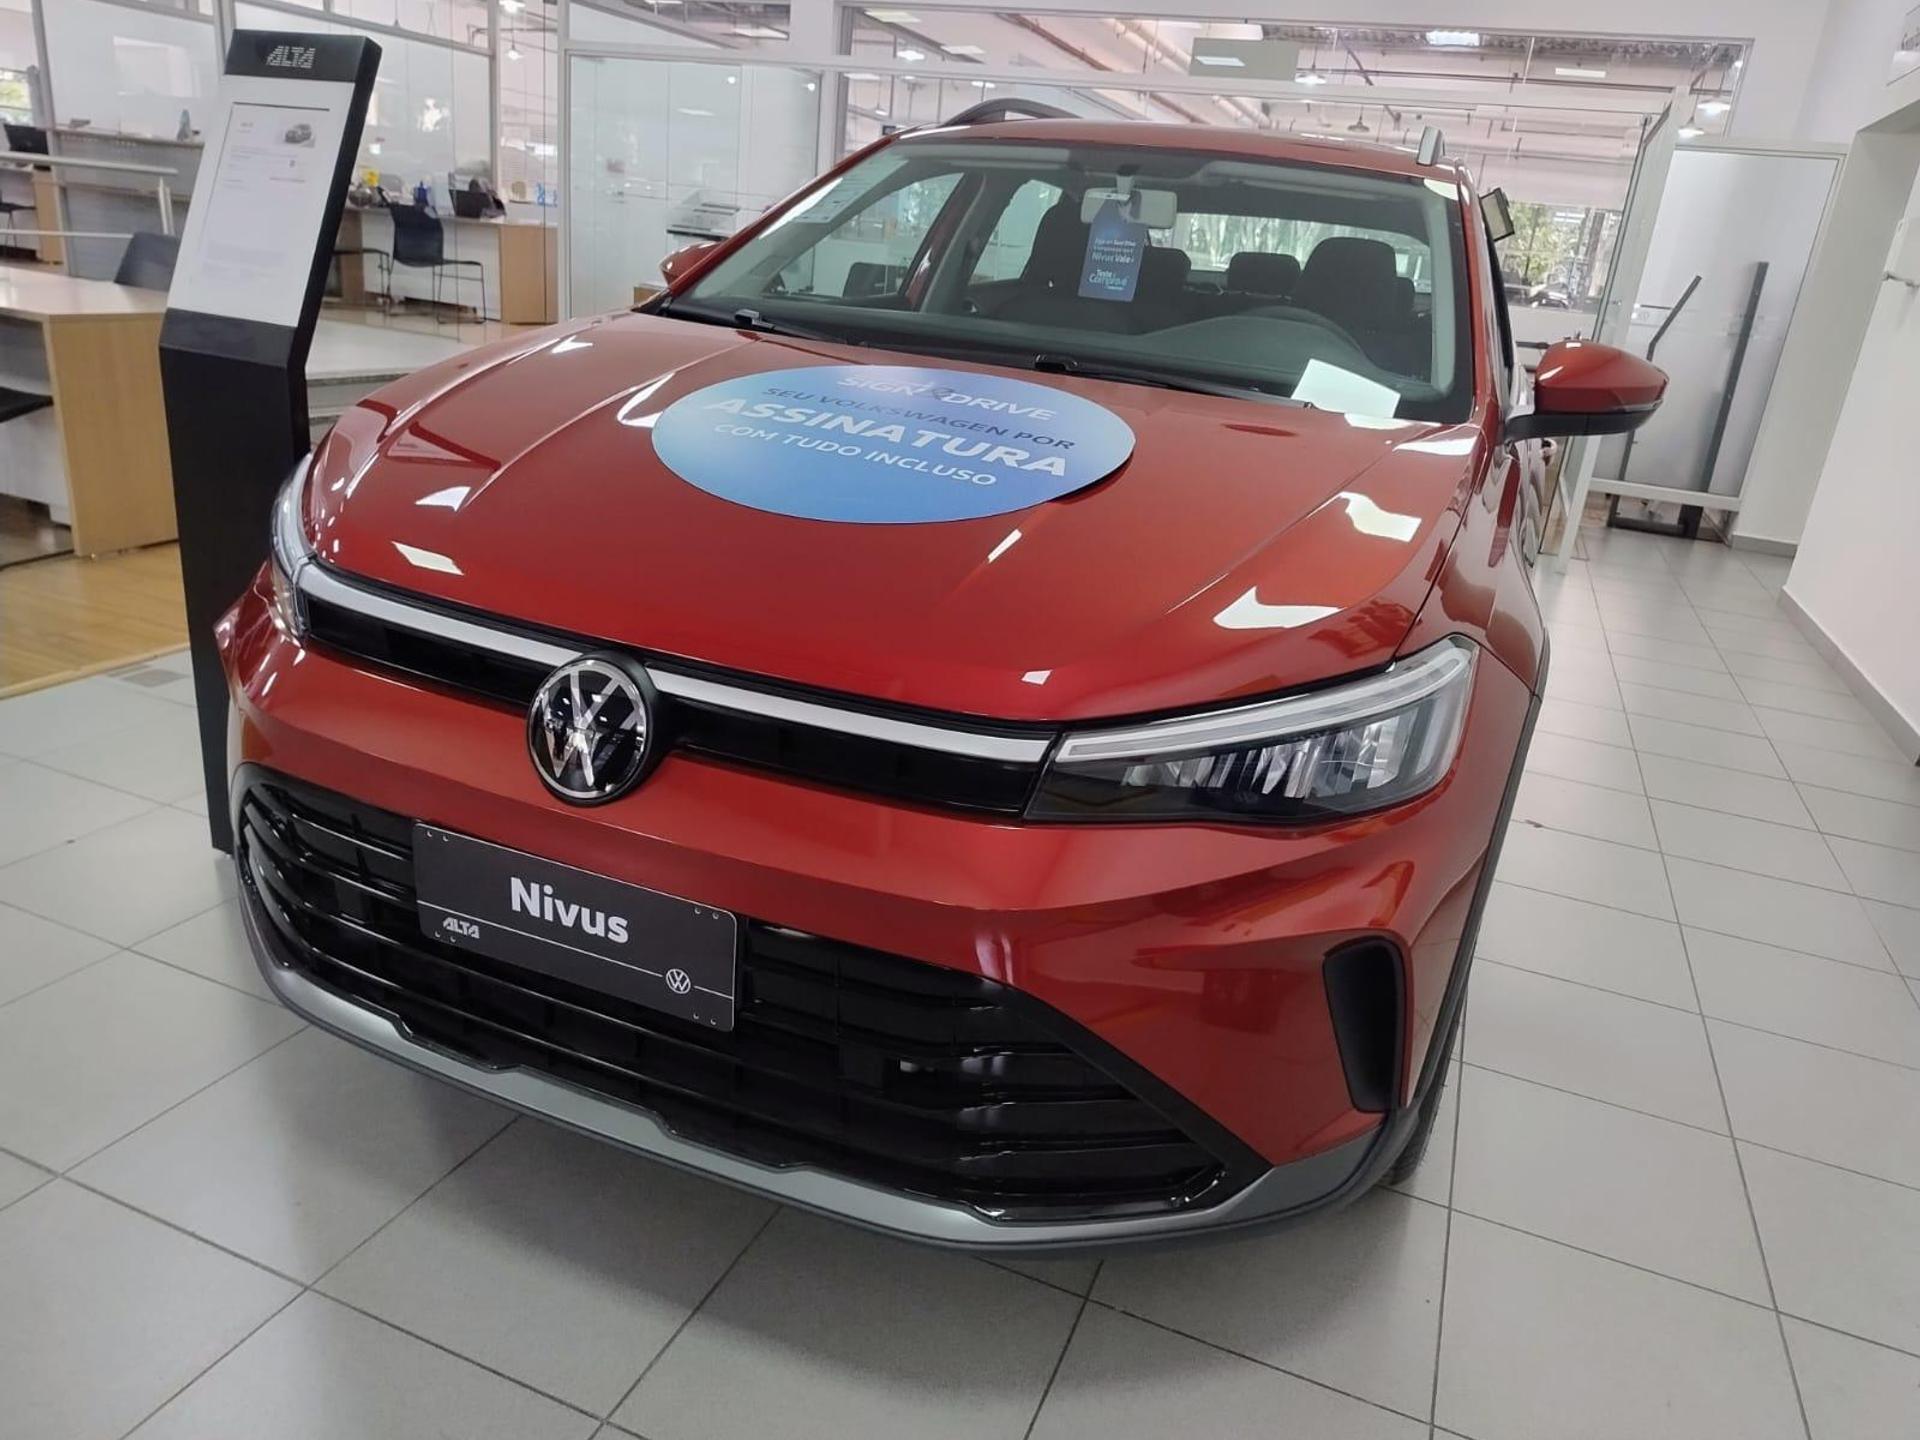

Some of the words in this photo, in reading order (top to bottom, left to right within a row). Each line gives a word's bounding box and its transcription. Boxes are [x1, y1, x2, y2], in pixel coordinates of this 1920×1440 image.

[266, 46, 316, 69] ALTA
[703, 398, 1066, 477] ASSINATURA
[763, 387, 815, 401] SEU
[819, 395, 1009, 436] VOLKSWAGEN
[1013, 431, 1075, 450] POR
[714, 423, 779, 440] COM
[783, 433, 861, 456] TUDO
[864, 450, 997, 485] INCLUSO
[443, 916, 481, 940] ALTA
[510, 876, 629, 943] Nivus
